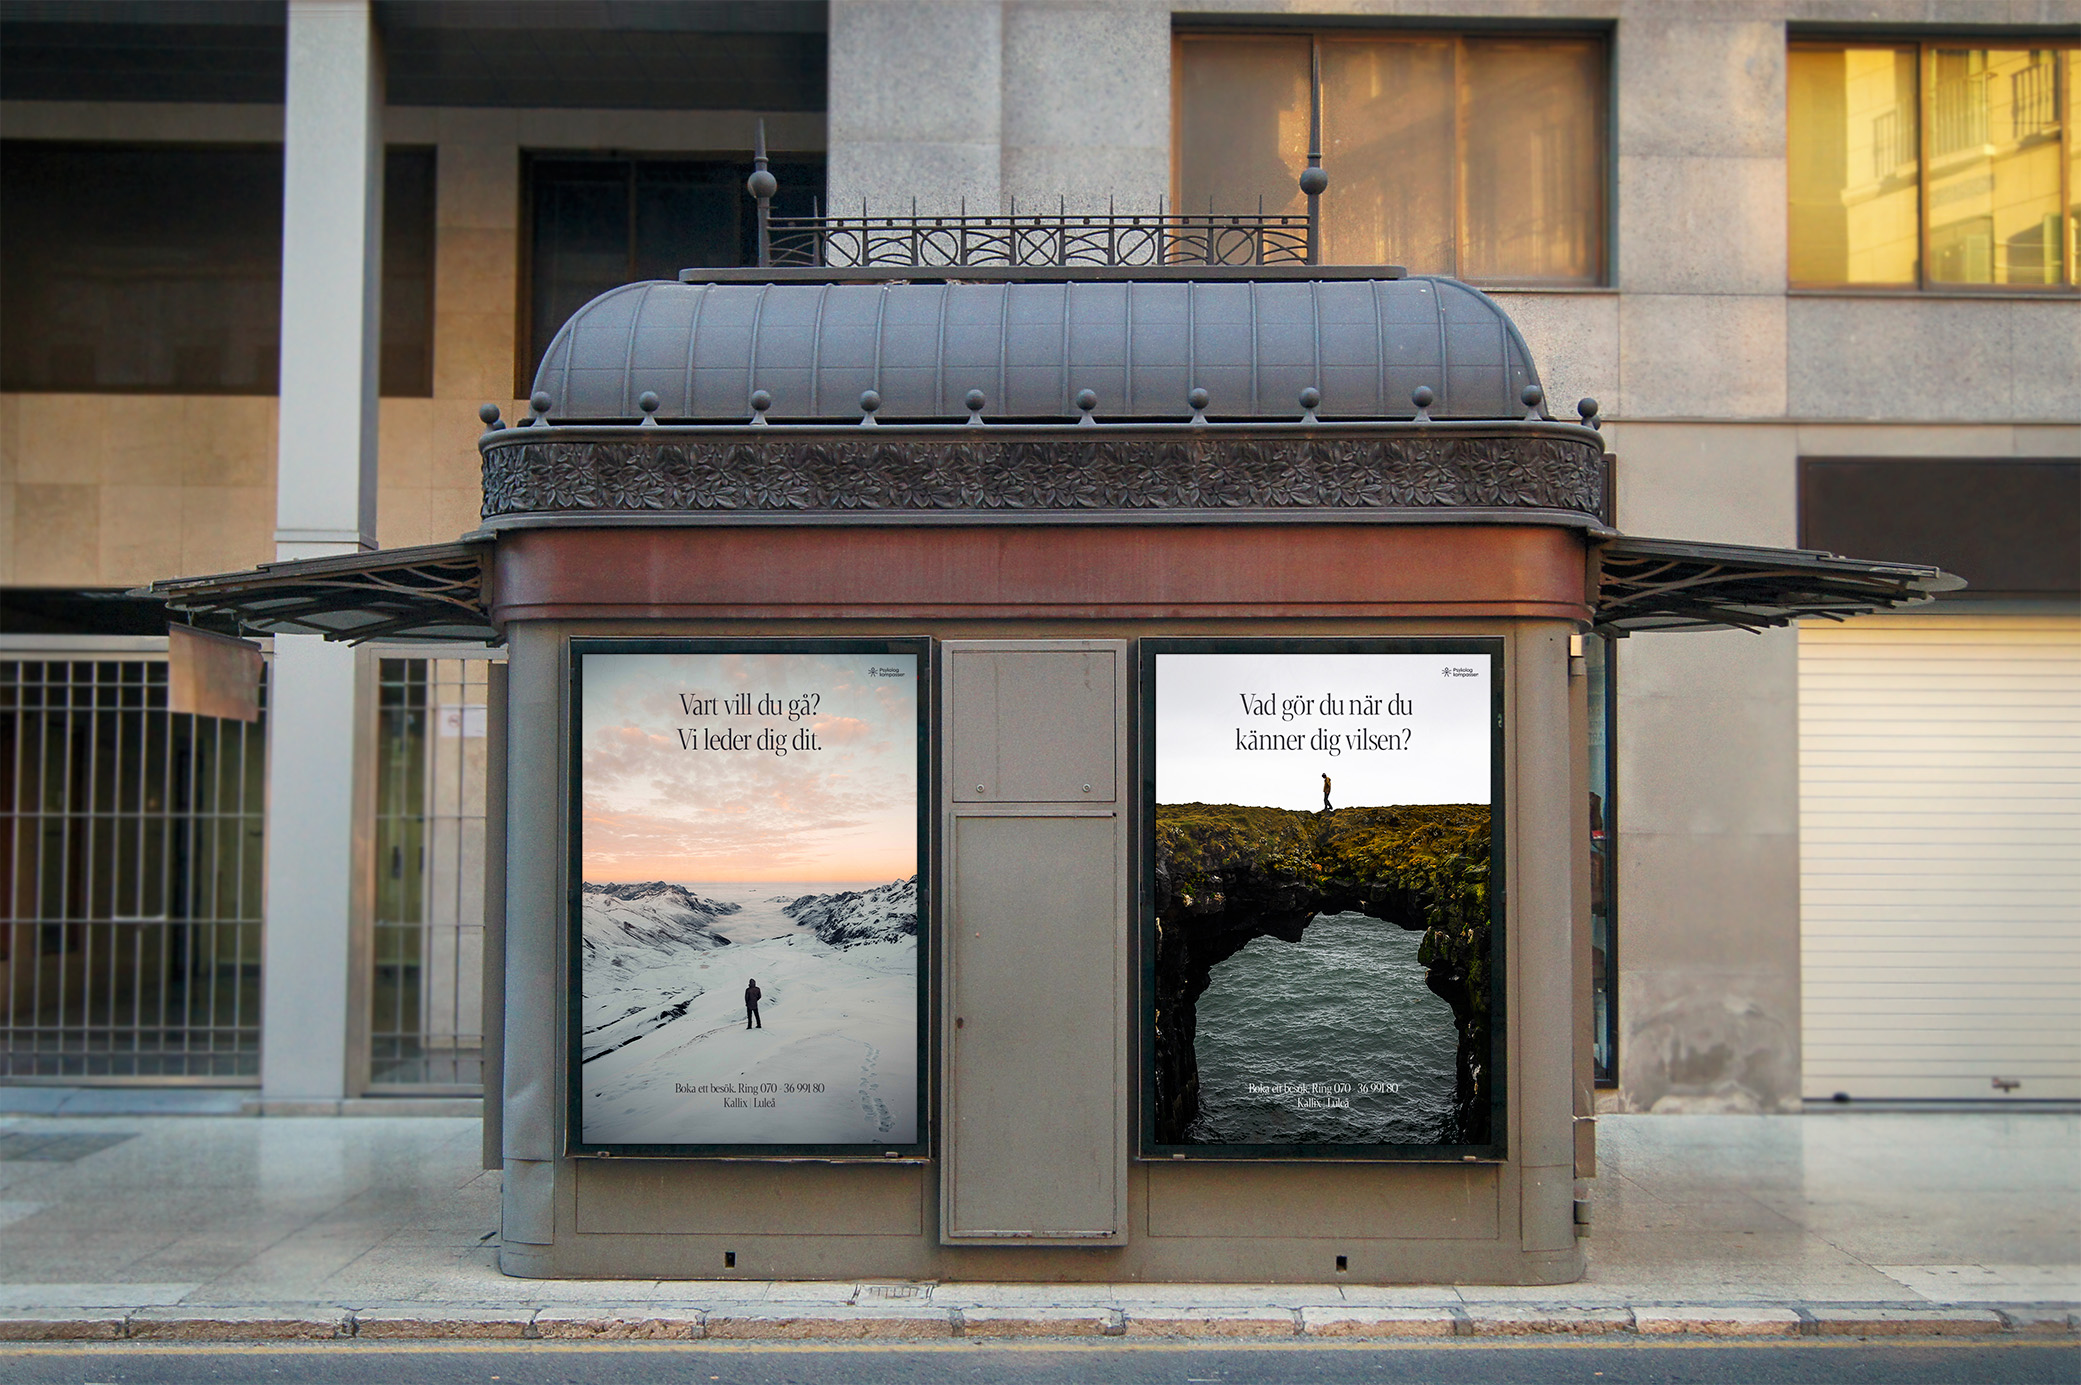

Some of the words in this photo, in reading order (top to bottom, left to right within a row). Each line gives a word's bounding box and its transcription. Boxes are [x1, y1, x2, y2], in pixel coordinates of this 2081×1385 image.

[679, 693, 718, 716] Vart
[723, 692, 752, 716] vill
[757, 692, 783, 716] du
[788, 692, 821, 722] gå?
[1239, 692, 1277, 716] Vad
[1282, 694, 1315, 722] gör
[1319, 692, 1345, 716] du
[1349, 694, 1383, 716] när
[1387, 692, 1413, 716] du
[677, 728, 698, 751] Vi
[703, 727, 753, 751] leder
[757, 727, 788, 757] dig
[792, 727, 822, 751] dit.
[1235, 727, 1306, 751] känner
[1310, 727, 1342, 757] dig
[1346, 727, 1412, 751] vilsen?
[675, 1082, 697, 1094] Boka
[698, 1083, 709, 1094] ett
[710, 1082, 737, 1094] besök.
[738, 1082, 759, 1096] Ring
[760, 1082, 778, 1094] 070
[784, 1082, 795, 1094] 36
[797, 1082, 811, 1094] 991
[812, 1082, 826, 1094] 80
[1248, 1082, 1270, 1094] Boka
[1311, 1082, 1333, 1096] Ring
[1334, 1082, 1352, 1094] 070
[1357, 1082, 1369, 1094] 36
[1385, 1082, 1399, 1094] 80
[723, 1097, 748, 1108] Kallix
[753, 1097, 776, 1108] Luleå
[1297, 1097, 1322, 1108] Kallix
